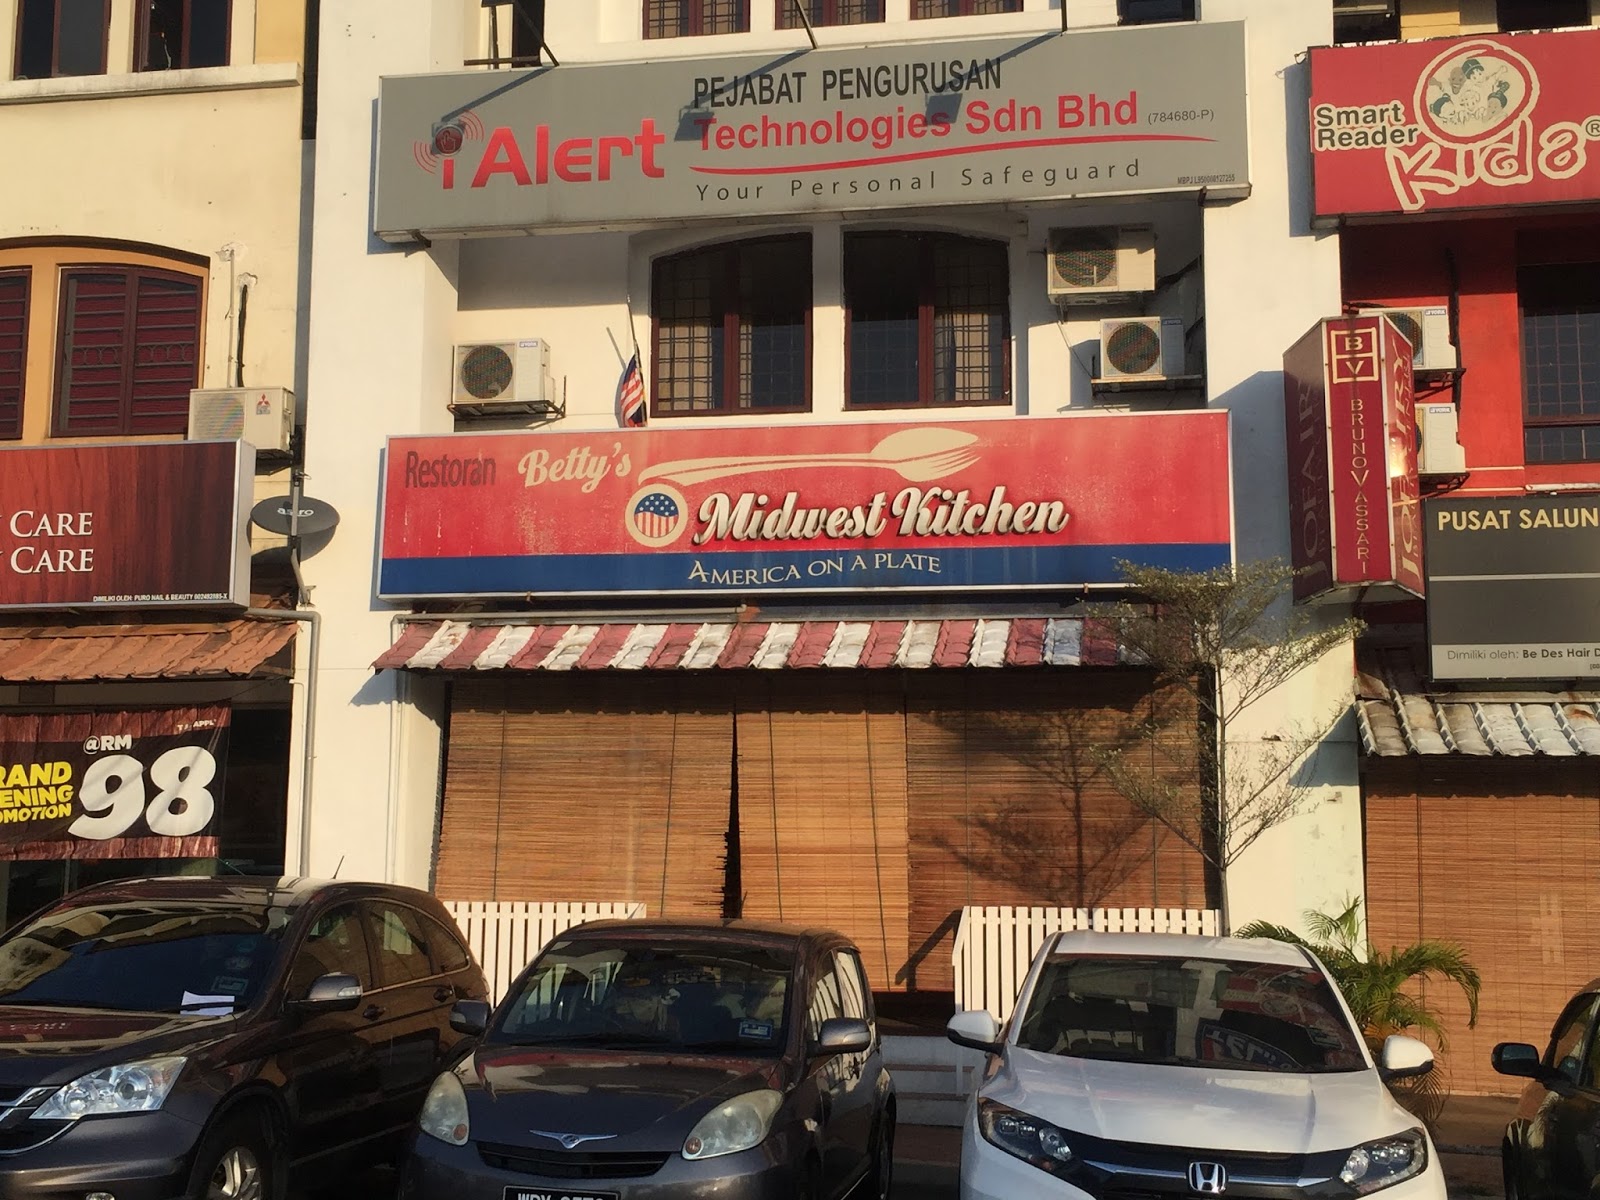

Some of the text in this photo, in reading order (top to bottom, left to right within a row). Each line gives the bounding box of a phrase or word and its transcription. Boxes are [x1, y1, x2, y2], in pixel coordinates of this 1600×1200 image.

[694, 58, 1001, 108] PEJABAT PENGURUSAN
[693, 91, 1215, 150] Technologies Sdn Bhd (784680-P)
[1315, 103, 1402, 128] Smart
[1317, 126, 1418, 148] Reader
[696, 159, 1139, 201] Your Personal Safeguard
[405, 442, 632, 493] Restoran Betty's
[9, 510, 93, 538] CARE
[277, 507, 315, 518] asro
[692, 485, 1071, 546] Midwest Kitchen
[1438, 507, 1599, 531] PUSAT SALUN
[10, 546, 94, 574] CARE
[688, 553, 942, 586] AMERICA ON A PLATE
[1447, 649, 1486, 660] Dimiliki
[1490, 649, 1519, 659] oleh:
[1523, 648, 1537, 658] Be
[1541, 648, 1563, 658] Des
[1567, 647, 1590, 658] Hair
[193, 719, 216, 728] APPL
[83, 734, 133, 755] @RM
[67, 745, 217, 840] 98
